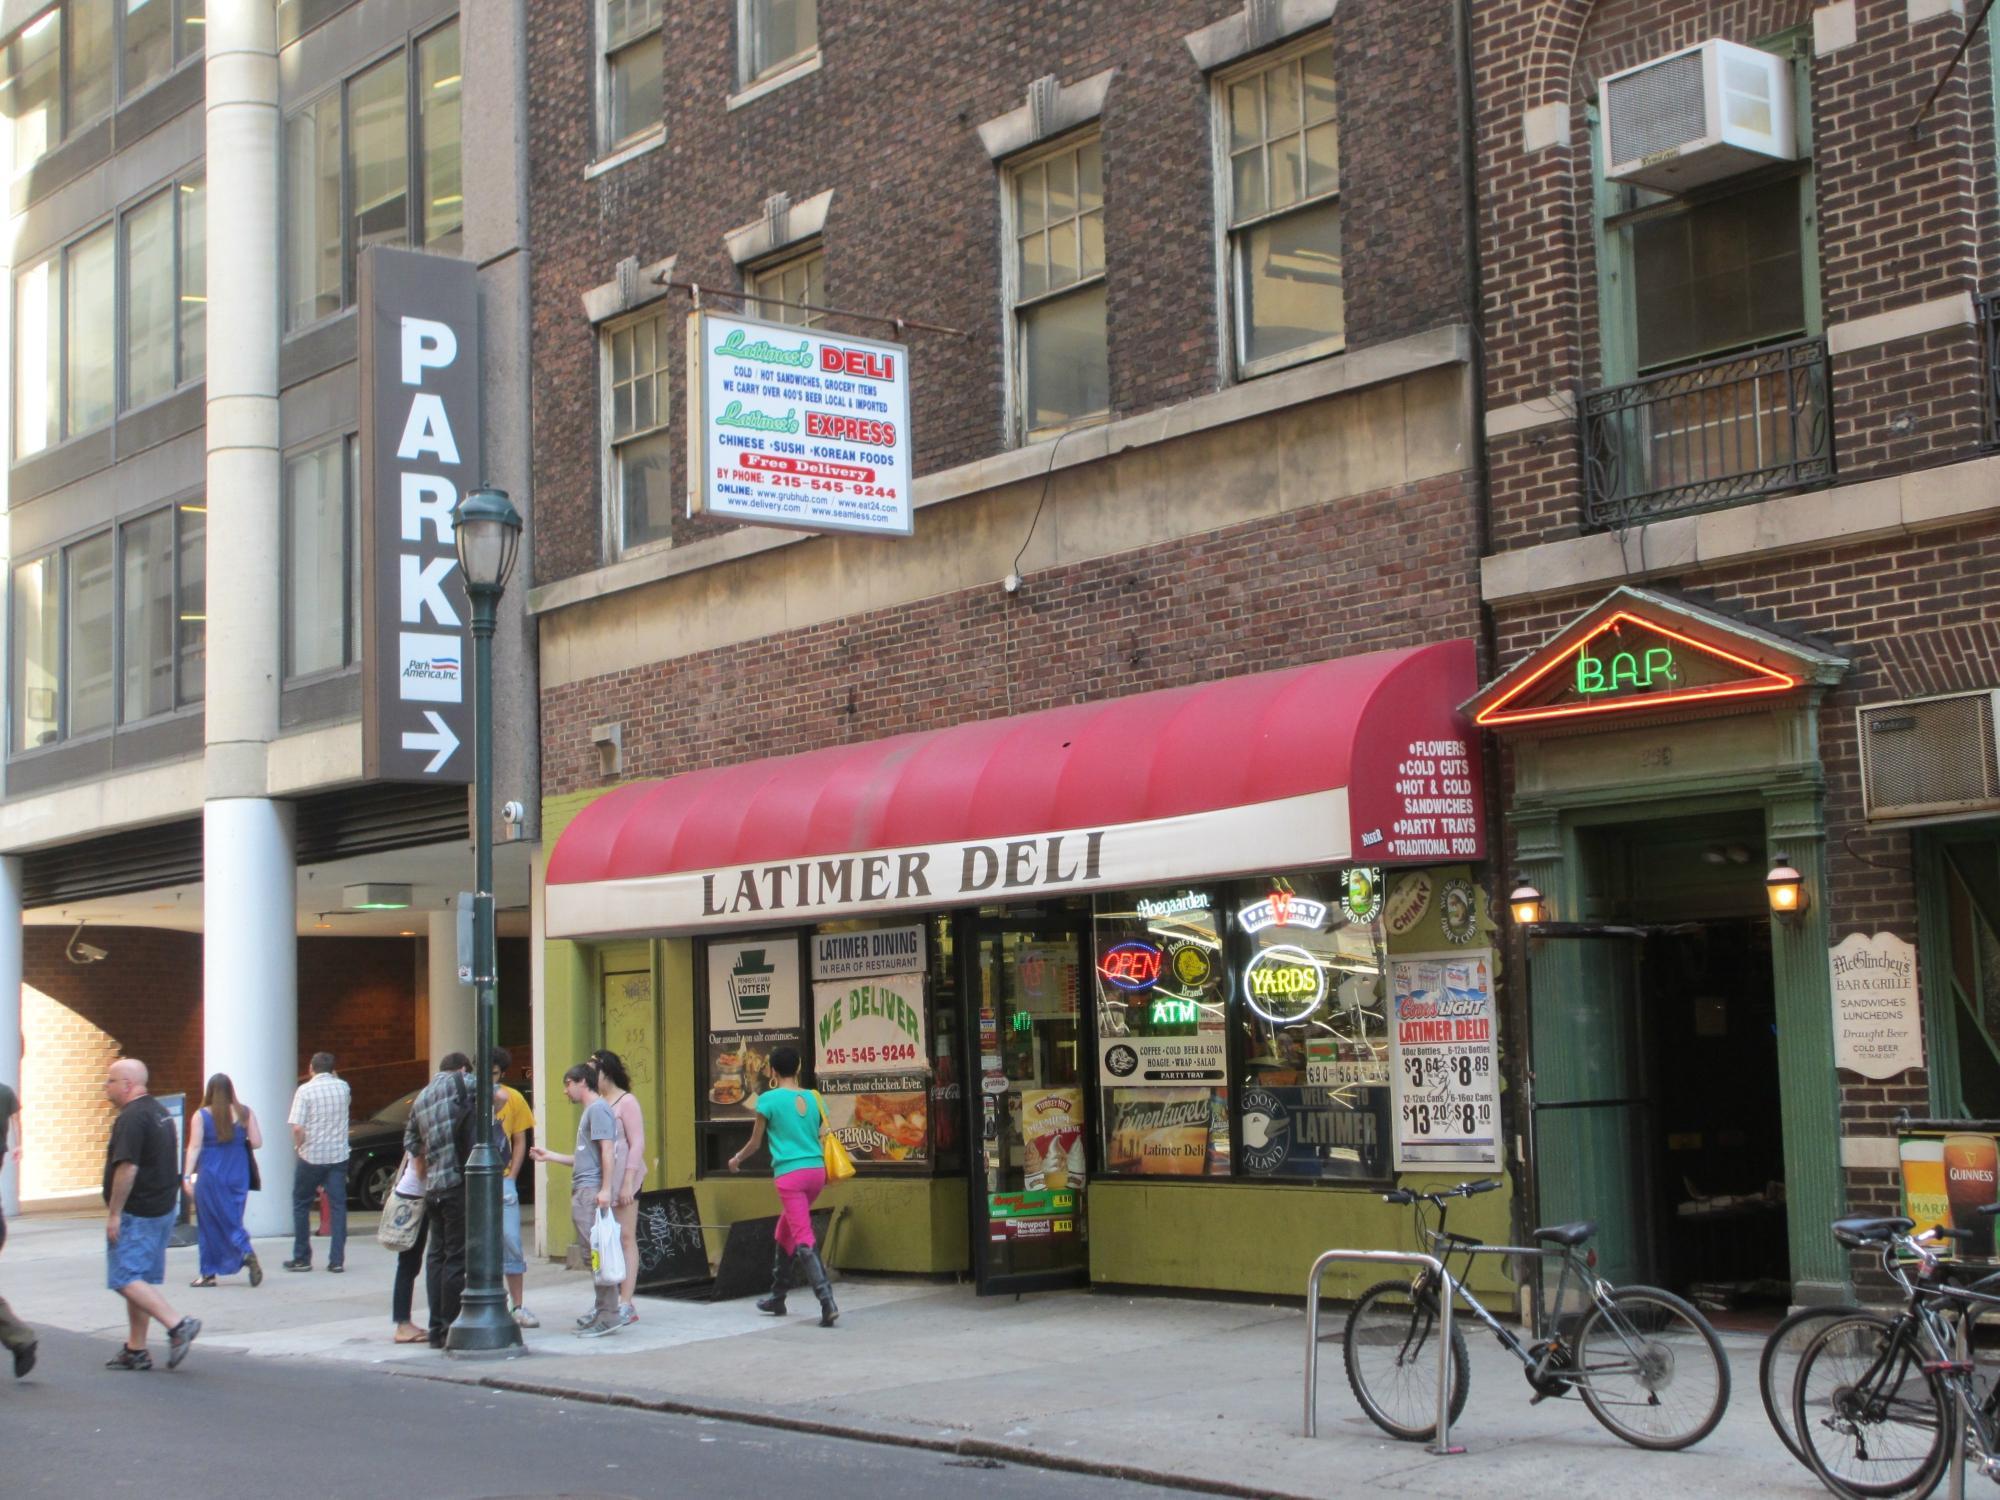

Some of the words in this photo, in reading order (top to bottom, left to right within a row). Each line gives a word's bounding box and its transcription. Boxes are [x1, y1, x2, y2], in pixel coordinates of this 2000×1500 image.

[821, 345, 894, 382] DELI
[734, 366, 752, 378] COLD
[761, 369, 773, 381] HOT
[777, 372, 822, 389] SANDWICHES,
[825, 379, 856, 393] GROCERY
[858, 384, 877, 396] ITEMS
[723, 380, 734, 391] WE
[737, 383, 759, 395] CARRY
[763, 387, 780, 398] OVER
[783, 389, 802, 401] 400'S
[805, 392, 822, 404] BEER
[825, 395, 845, 407] LOCAL
[849, 399, 853, 408] &
[856, 400, 887, 413] IMPORTED
[805, 410, 896, 447] EXPRESS
[719, 434, 764, 449] CHINESE
[860, 452, 894, 466] FOODS
[397, 316, 462, 627] PARK
[748, 454, 787, 469] Free
[795, 461, 868, 480] Delivery
[717, 468, 729, 479] BY
[733, 471, 764, 484] PHONE:
[771, 474, 896, 499] 215-545-9244
[717, 483, 753, 496] ONLINE:
[757, 489, 828, 505] www.grubhub.com
[838, 499, 898, 513] www.eat24.com
[728, 497, 800, 513] www.delivery.com
[812, 506, 889, 523] www.seamless.com
[410, 660, 430, 670] Park
[1577, 648, 1676, 693] BAR
[1415, 741, 1466, 756] FLOWERS
[1407, 760, 1435, 775] COLD
[1440, 760, 1469, 775] CUTS
[1402, 780, 1424, 794] HOT
[1431, 780, 1438, 794] &
[1444, 780, 1471, 794] COLD
[1405, 798, 1473, 814] SANDWICHES
[1401, 819, 1436, 834] PARTY
[1441, 818, 1475, 833] TRAYS
[1395, 839, 1450, 855] TRADITIONAL
[1452, 838, 1476, 854] FOOD
[702, 852, 932, 917] LATIMER
[959, 832, 1105, 892] DELI
[1137, 891, 1210, 920] Hoegaarden
[1361, 894, 1381, 925] CIDER
[1393, 881, 1429, 930] CHIMAY
[820, 936, 868, 961] LATIMER
[873, 931, 917, 957] DINING
[820, 965, 828, 974] IN
[831, 962, 850, 973] REAR
[854, 962, 863, 971] OF
[866, 957, 917, 970] RESTAURANT
[1104, 951, 1162, 979] OPEN
[738, 984, 770, 994] LOTTERY
[1251, 968, 1316, 994] YARDS
[1836, 979, 1860, 991] BAR
[1862, 979, 1871, 990] &
[1872, 978, 1911, 989] GRILLE
[1154, 1002, 1196, 1023] ATM
[1400, 996, 1438, 1019] Coors
[1439, 1000, 1486, 1015] LIGHT
[1841, 999, 1906, 1008] SANDWICHES
[819, 997, 842, 1048] WE
[850, 985, 920, 1044] DELIVER
[1843, 1011, 1903, 1020] LUNCHEONS
[709, 1033, 721, 1044] Our
[754, 1032, 764, 1042] salt
[1400, 1020, 1452, 1042] LATIMER
[1843, 1029, 1884, 1042] Draught
[1887, 1030, 1908, 1039] Beer
[827, 1044, 915, 1064] 215-545-9244
[1140, 1046, 1161, 1055] COFFEE
[1166, 1046, 1181, 1055] COLD
[1184, 1046, 1198, 1054] BEER
[1207, 1045, 1222, 1054] SODA
[1402, 1048, 1416, 1056] 40oz
[1469, 1046, 1490, 1054] Bottles
[1148, 1059, 1169, 1067] HOAGIE
[1175, 1058, 1192, 1066] WRAP
[1197, 1058, 1216, 1066] SALAD
[822, 1080, 836, 1092] The
[837, 1080, 851, 1092] best
[853, 1082, 870, 1091] roast
[1241, 1094, 1280, 1113] GOOSE
[1475, 1093, 1492, 1101] Cans
[1296, 1112, 1377, 1144] LATIMER
[834, 1128, 889, 1154] ERROAST
[1143, 1144, 1181, 1156] Latimer
[1184, 1143, 1204, 1156] Deli
[1244, 1145, 1284, 1169] ISLAND
[1950, 1168, 1994, 1182] GUINNESS
[1018, 1220, 1050, 1228] Newport
